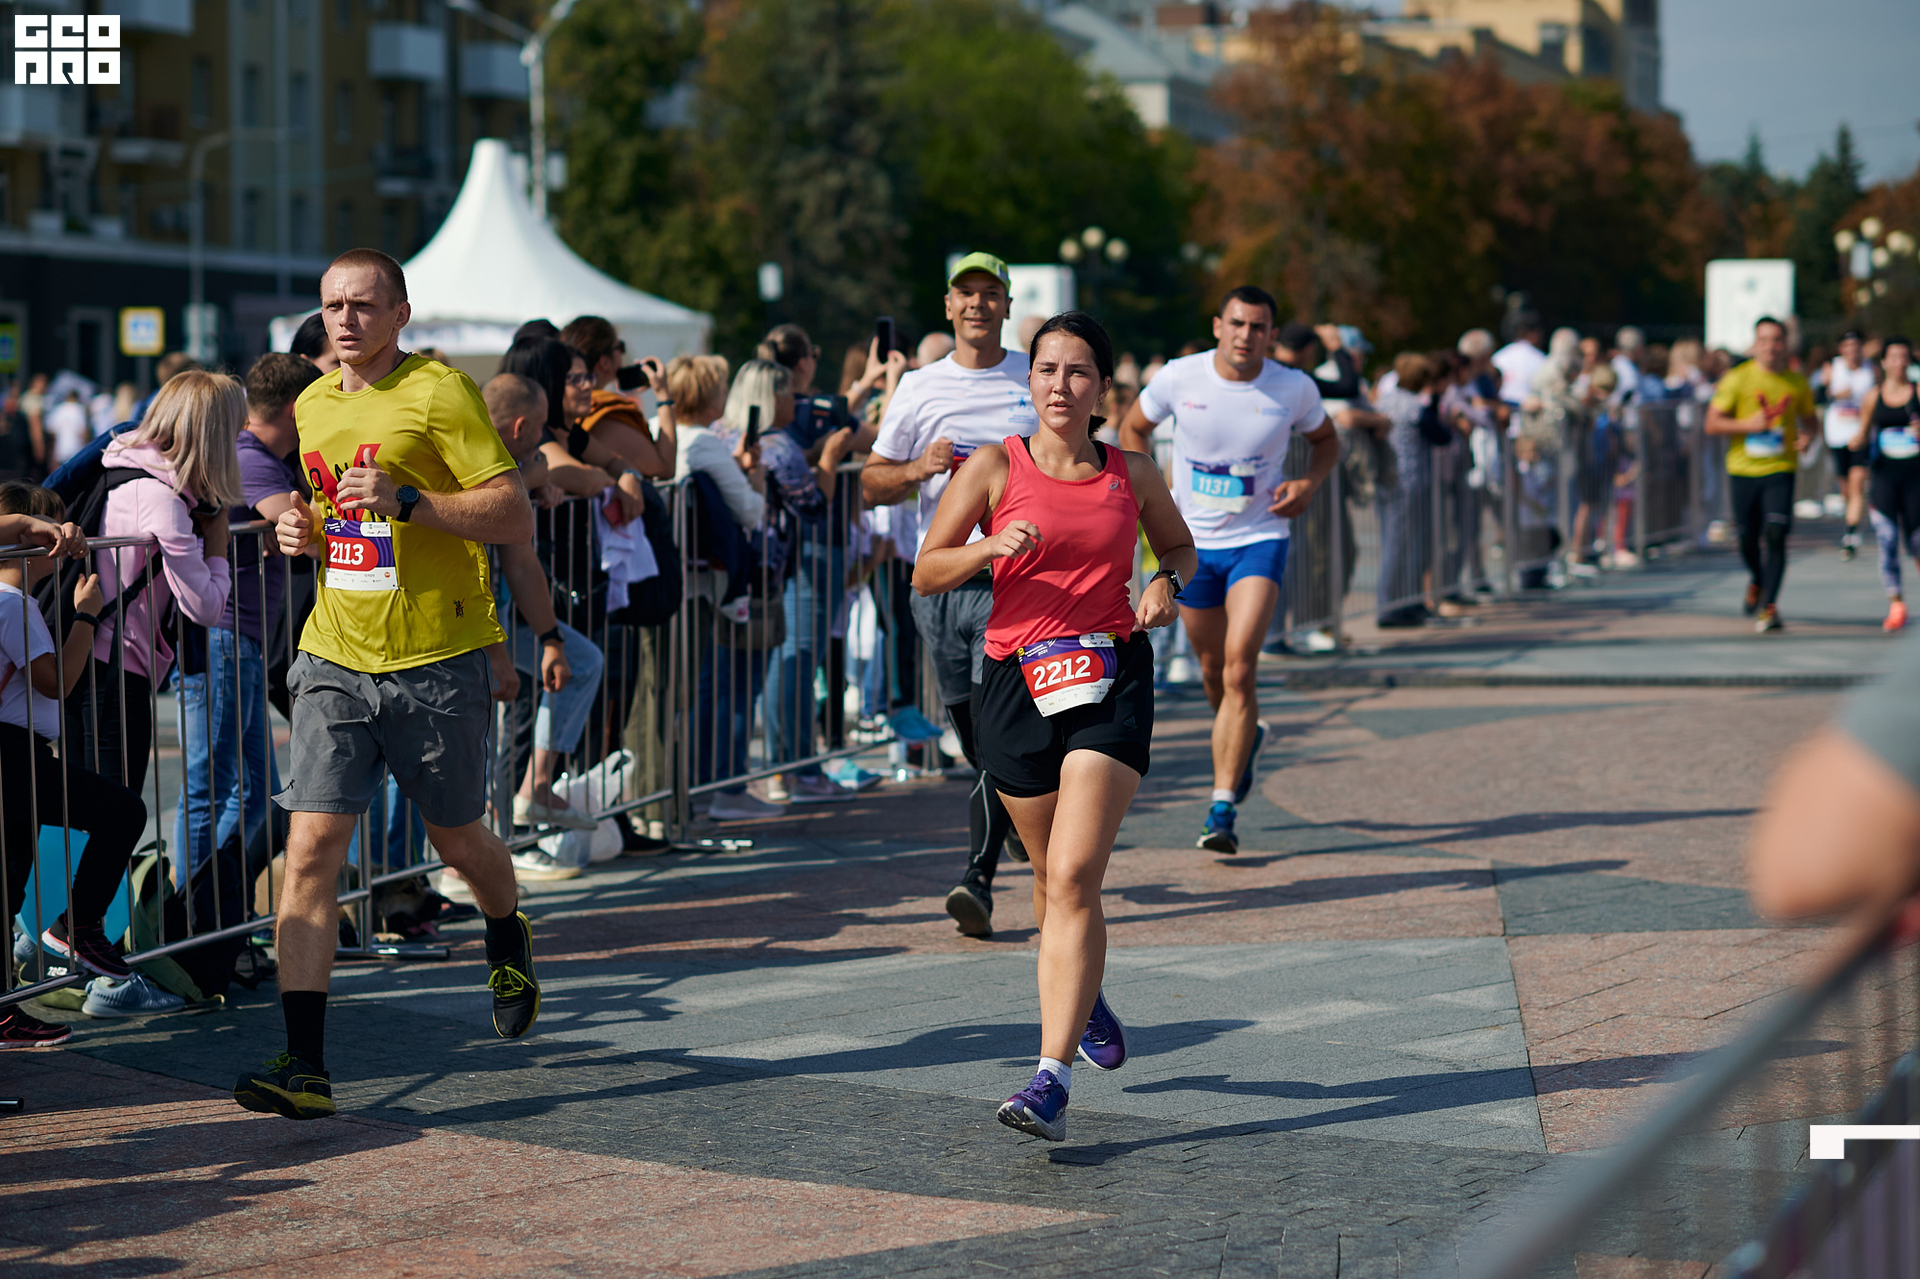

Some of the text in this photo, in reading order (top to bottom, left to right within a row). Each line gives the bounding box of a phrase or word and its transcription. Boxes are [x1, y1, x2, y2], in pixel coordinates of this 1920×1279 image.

[1199, 477, 1230, 495] 1131
[329, 541, 364, 566] 2113
[1032, 655, 1091, 691] 2212
